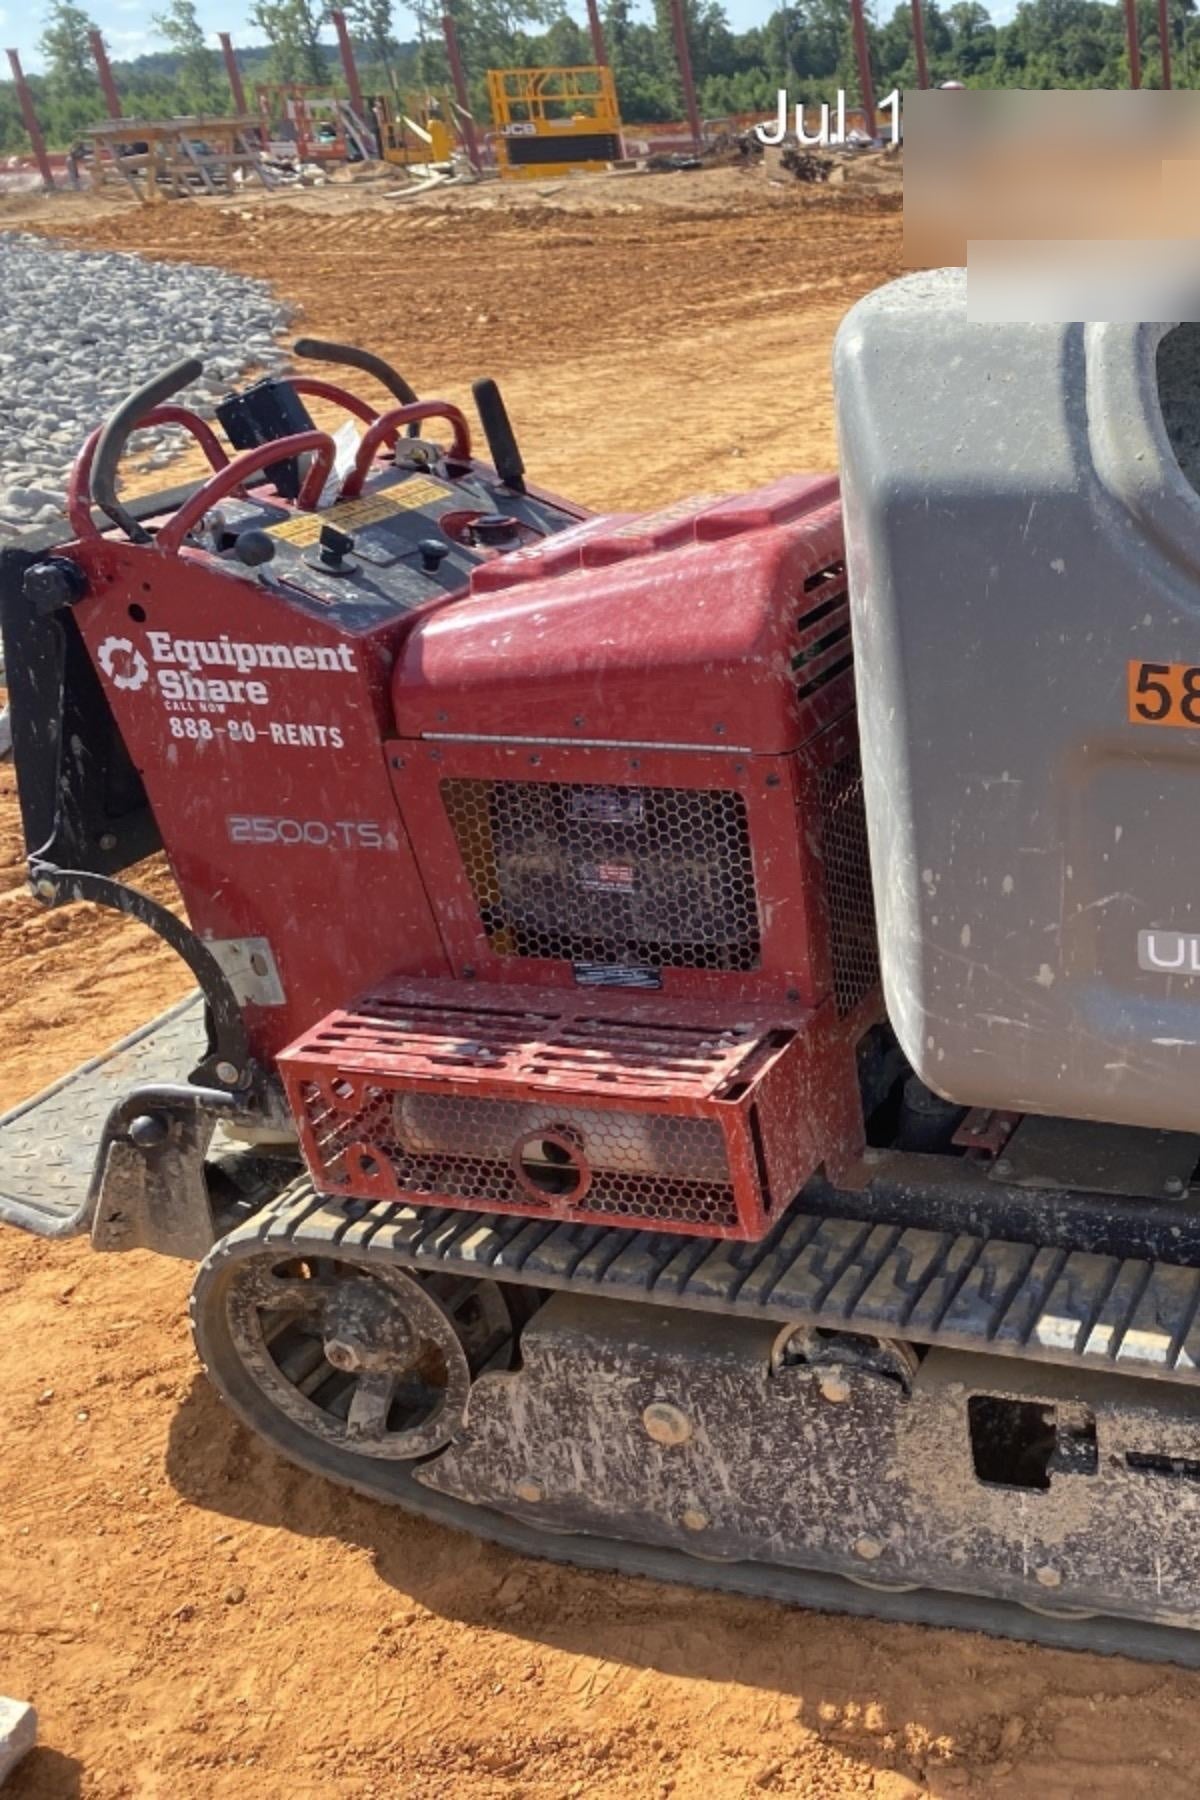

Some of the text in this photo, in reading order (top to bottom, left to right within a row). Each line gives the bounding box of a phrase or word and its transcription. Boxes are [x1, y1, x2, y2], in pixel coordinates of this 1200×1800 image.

[500, 123, 537, 136] JCB
[146, 631, 359, 674] Equipment
[156, 669, 269, 705] Share
[169, 716, 345, 749] 888-80-RENTS
